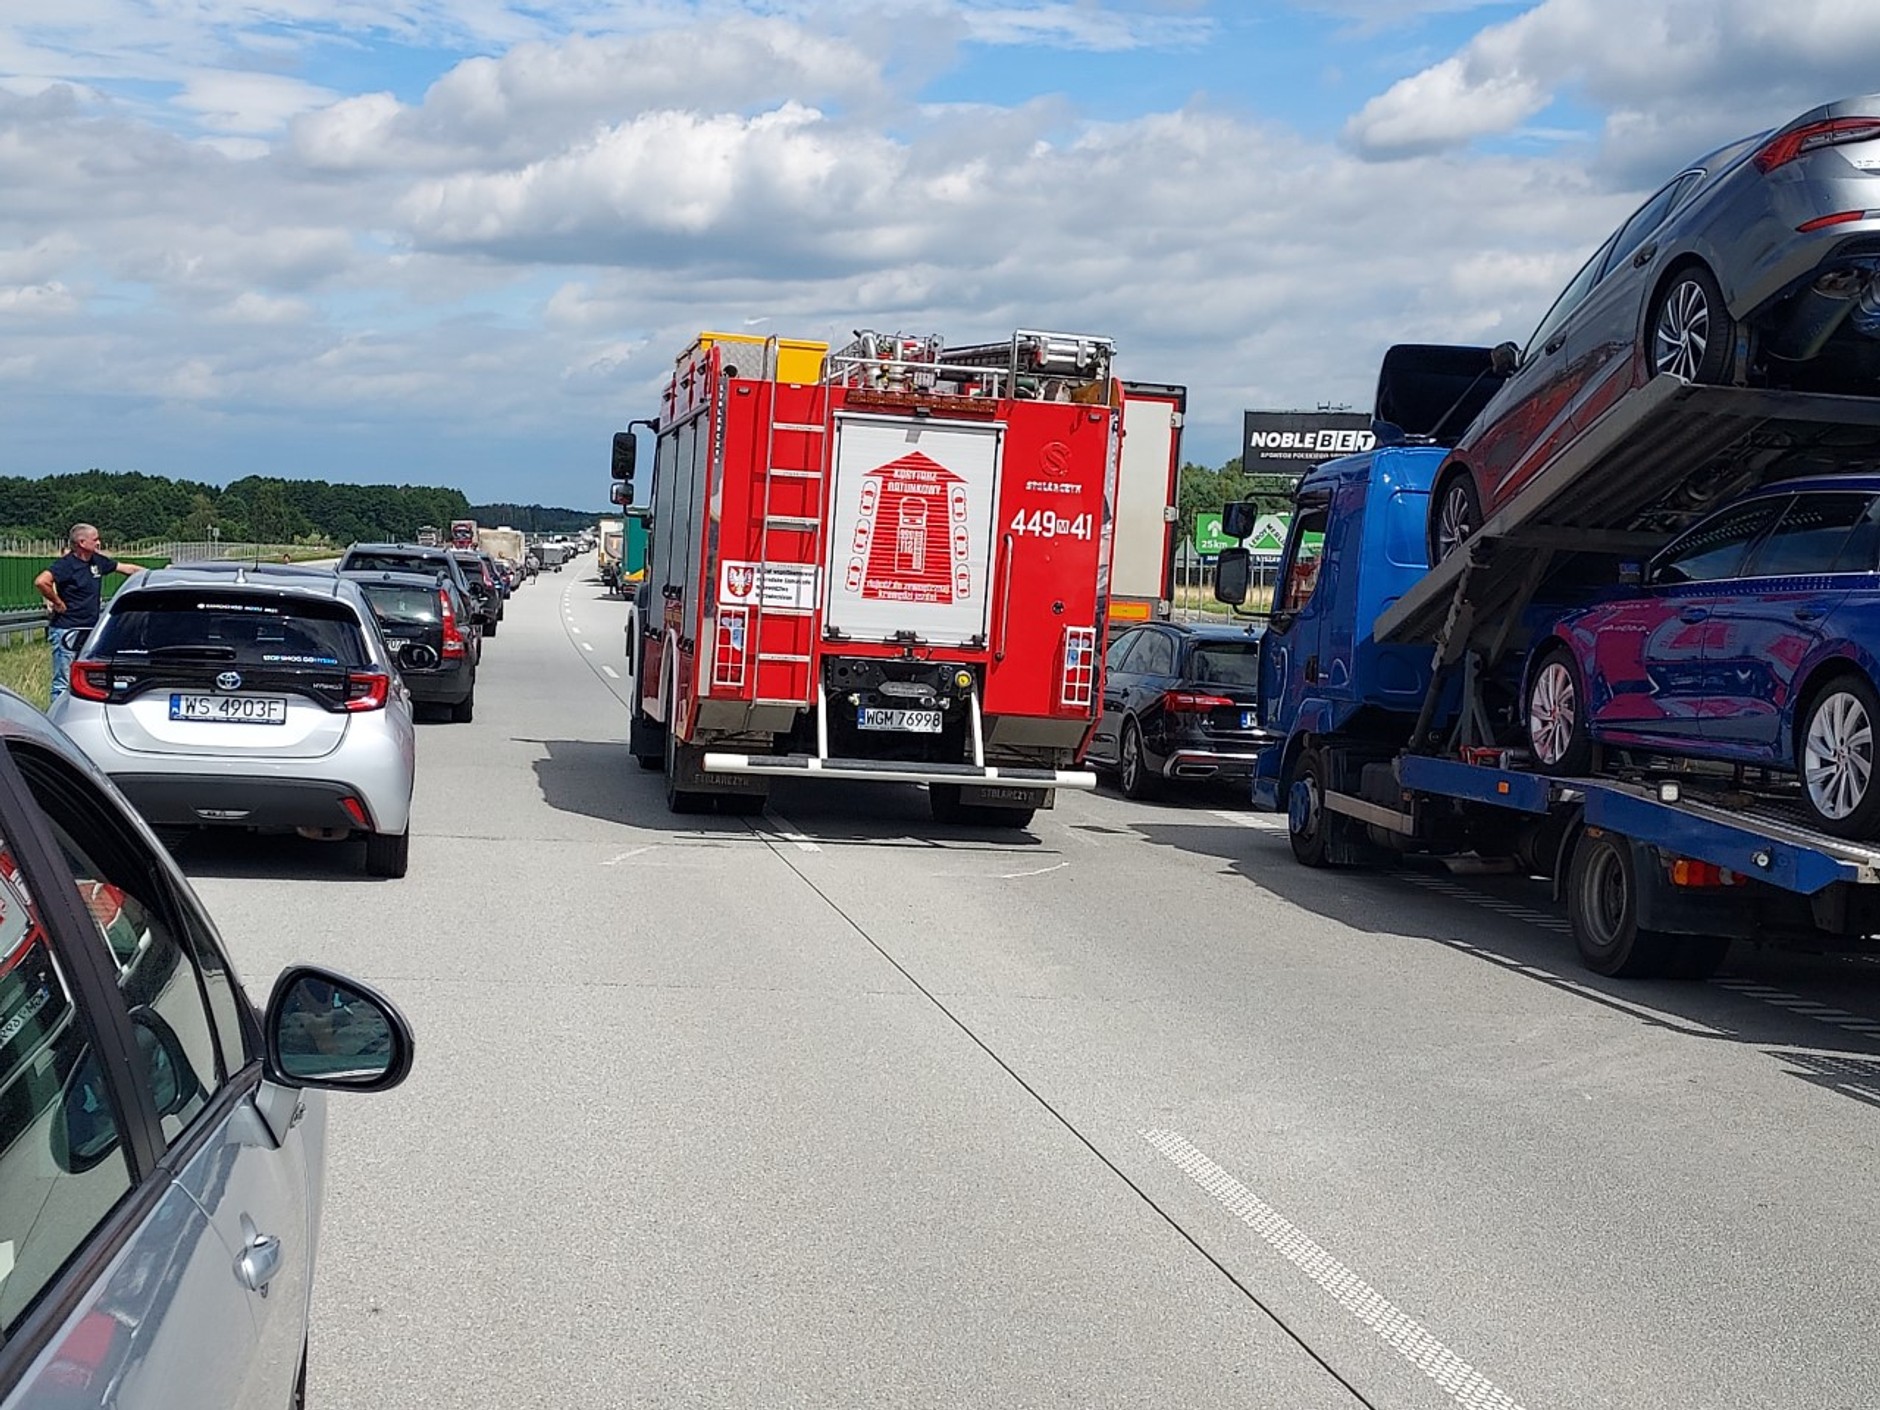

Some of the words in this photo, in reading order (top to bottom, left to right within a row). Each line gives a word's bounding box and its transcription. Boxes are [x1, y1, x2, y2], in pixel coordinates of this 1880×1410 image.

[1249, 528, 1267, 547] LEROY
[185, 697, 210, 715] WS
[219, 698, 280, 718] 4903F
[866, 711, 894, 726] WGM
[898, 712, 941, 727] 76998
